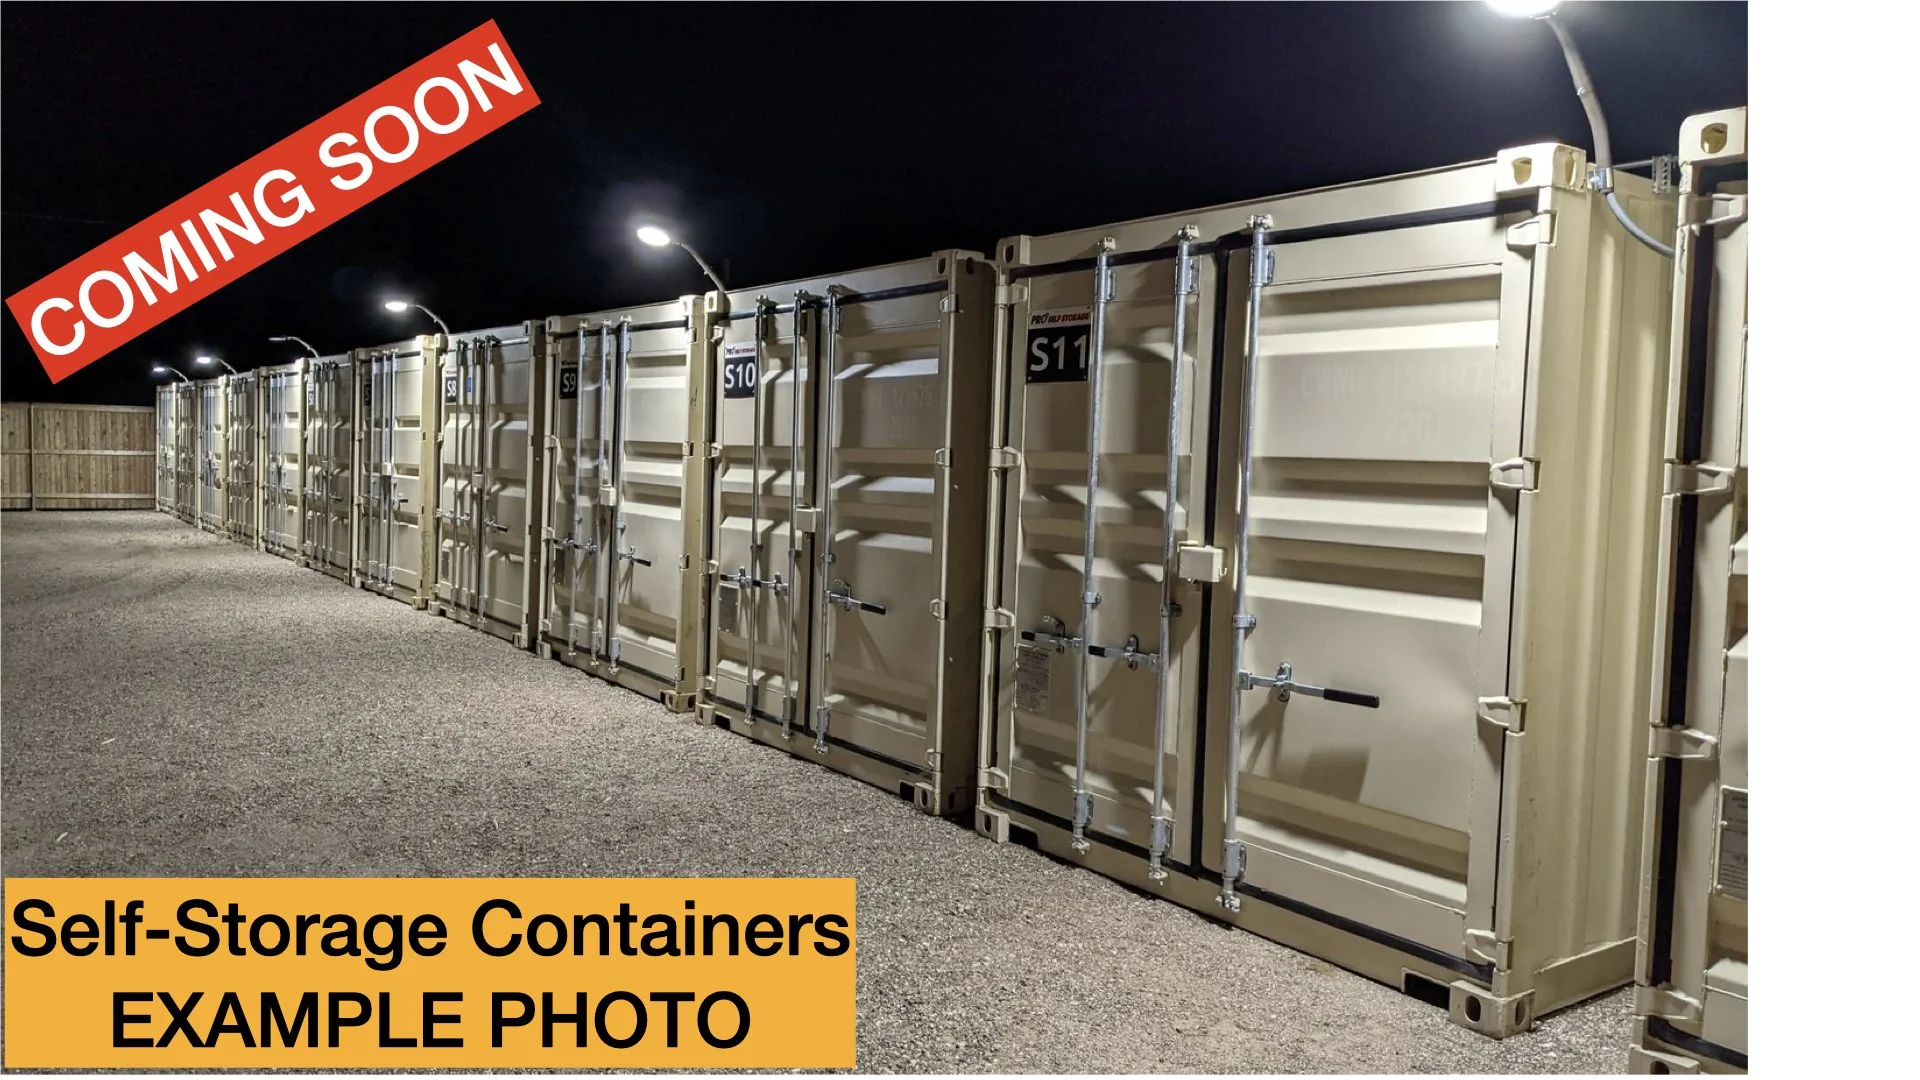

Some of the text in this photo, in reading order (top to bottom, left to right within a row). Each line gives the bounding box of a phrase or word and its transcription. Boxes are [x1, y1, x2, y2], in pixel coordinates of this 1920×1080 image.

[1031, 312, 1050, 325] PRO
[1030, 335, 1087, 372] S11
[562, 372, 576, 392] S9
[725, 362, 755, 389] S10
[447, 380, 457, 397] S8
